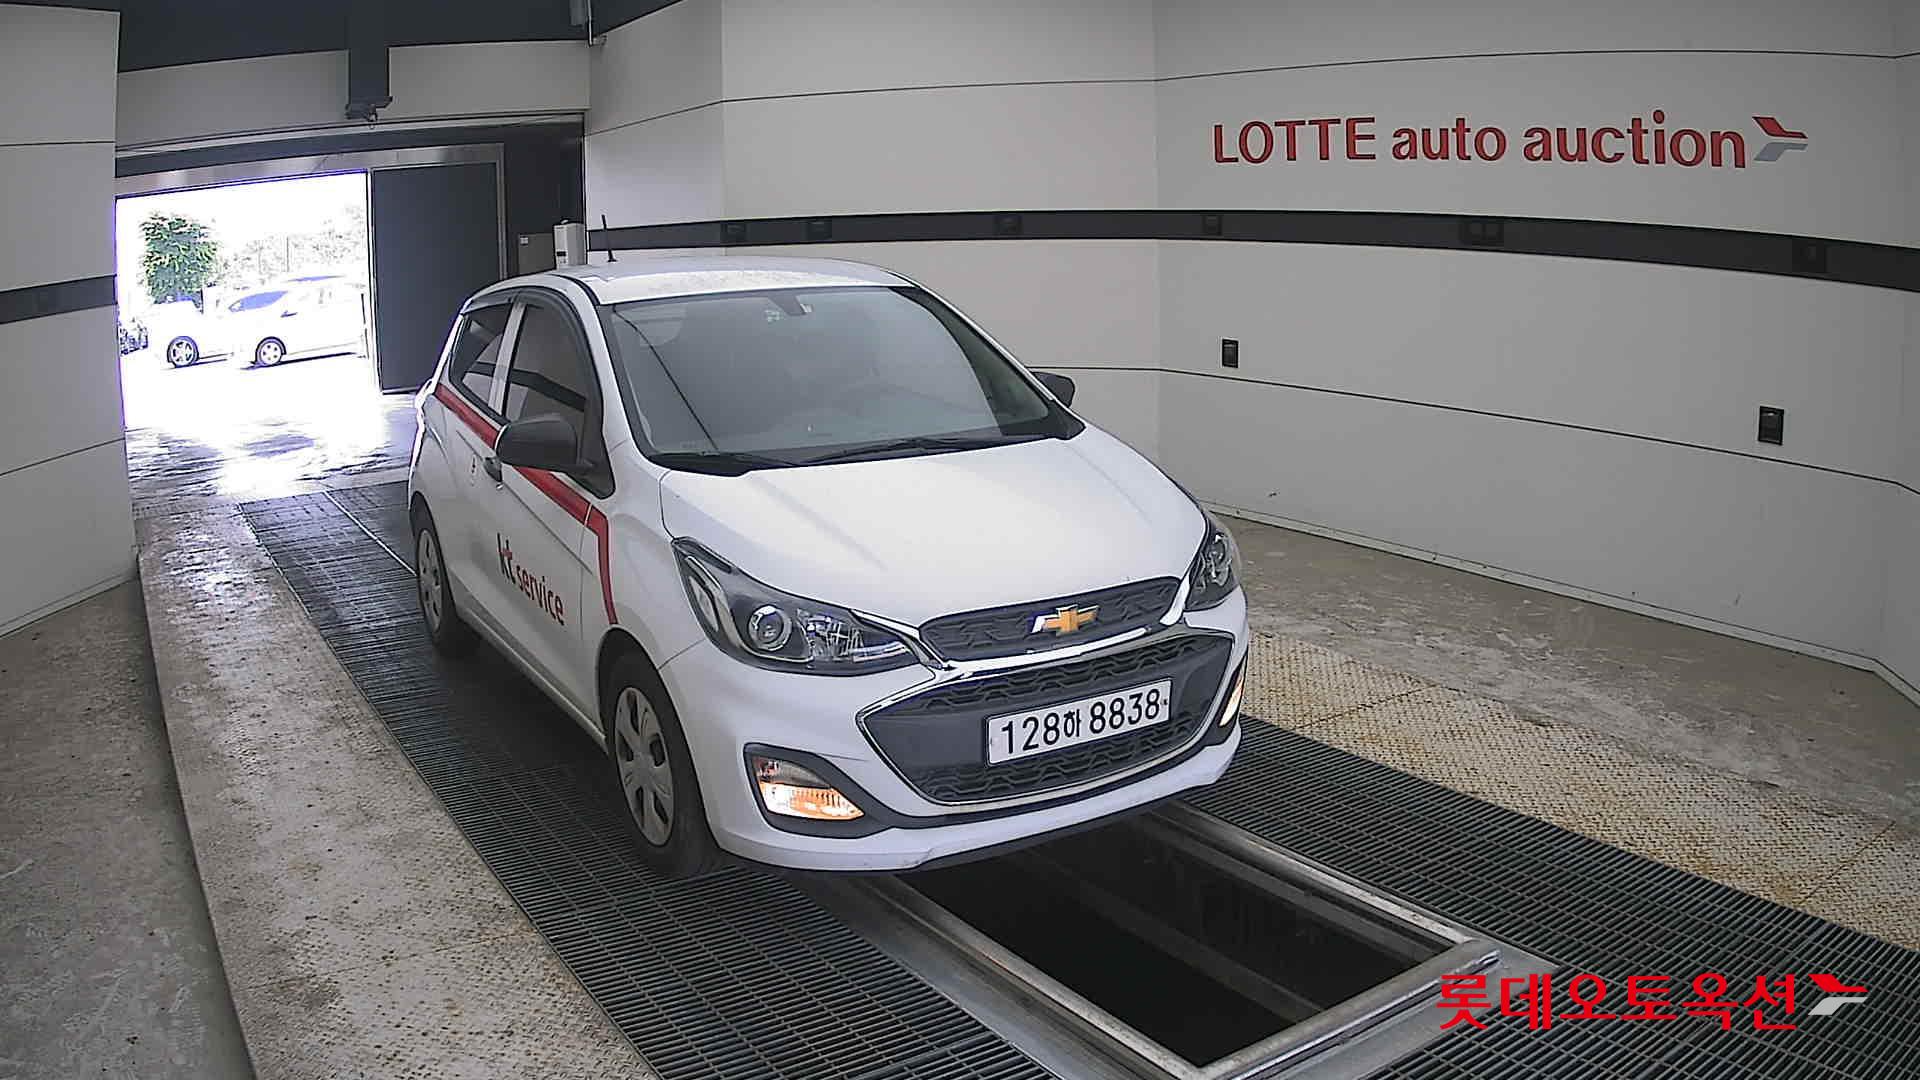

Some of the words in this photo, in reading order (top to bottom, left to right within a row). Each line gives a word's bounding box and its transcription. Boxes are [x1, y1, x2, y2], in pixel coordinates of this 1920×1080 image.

[1213, 116, 1376, 164] LOTTE
[1391, 116, 1507, 162] auto
[1522, 109, 1746, 169] auction
[496, 532, 516, 585] kt
[516, 565, 565, 626] service
[1001, 708, 1082, 755] 128하
[1089, 688, 1161, 735] 8838
